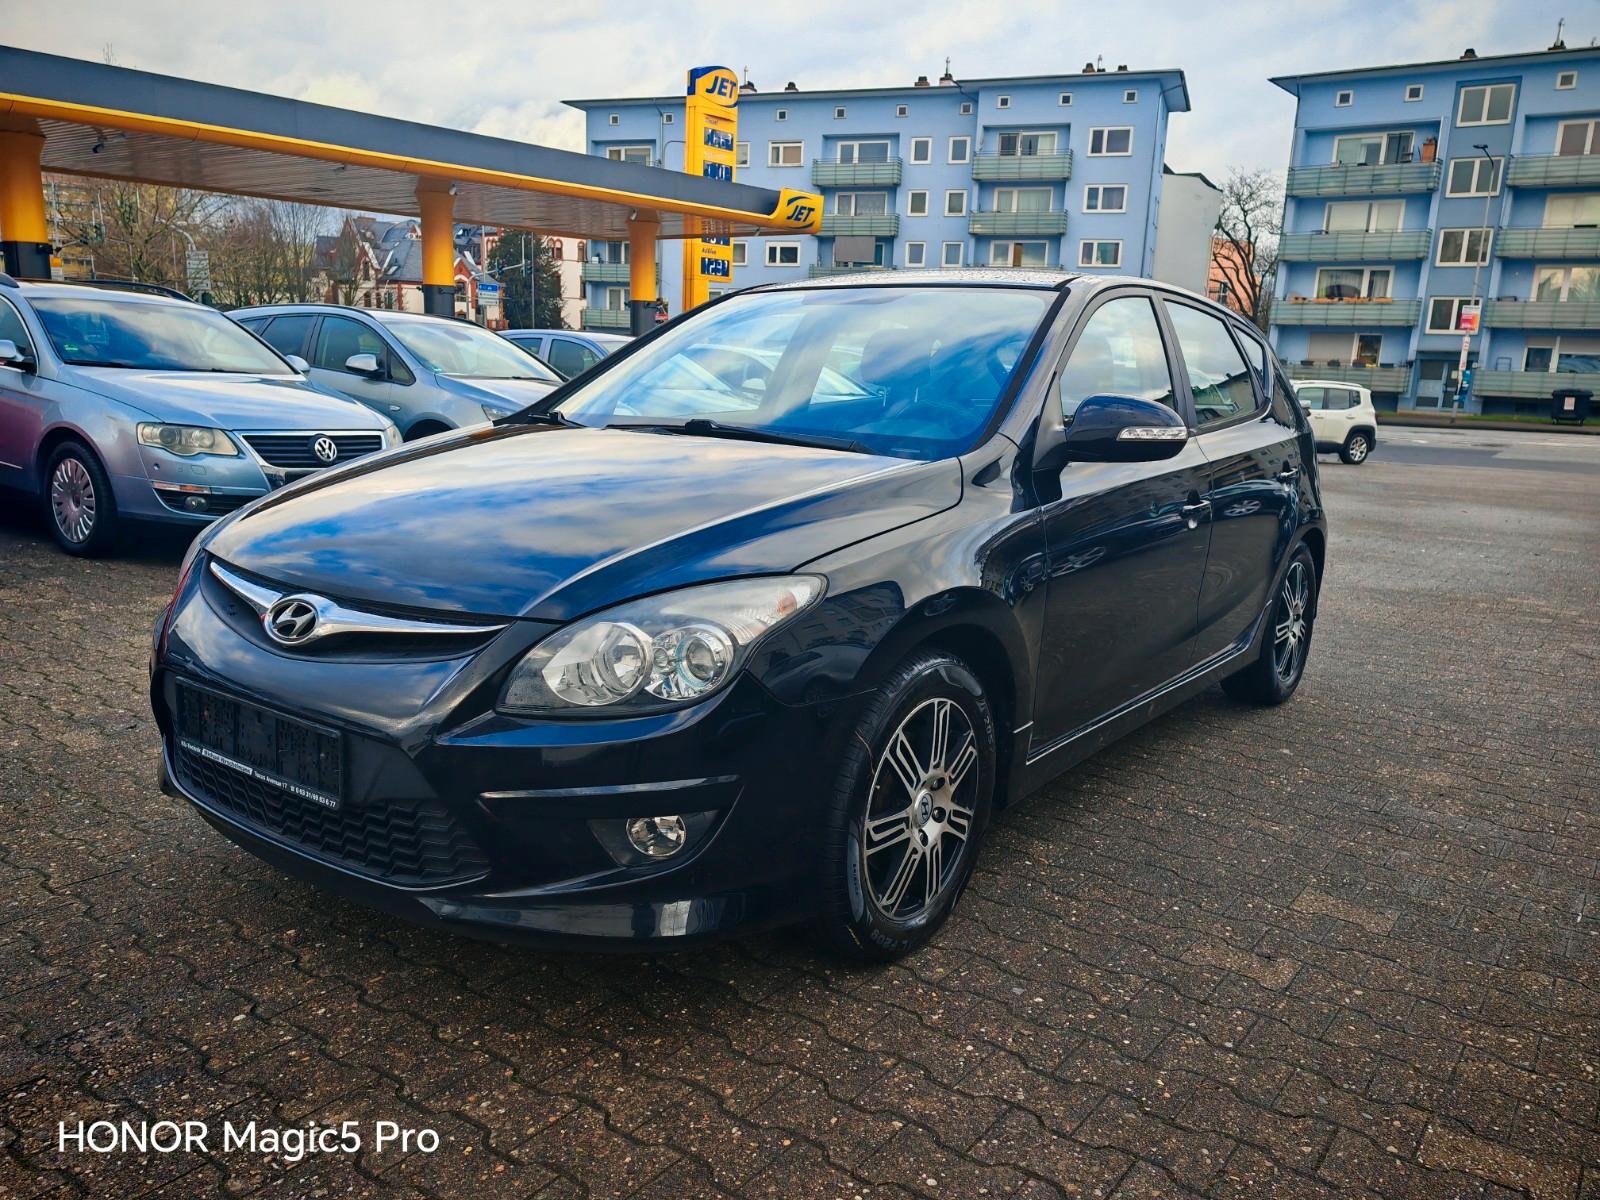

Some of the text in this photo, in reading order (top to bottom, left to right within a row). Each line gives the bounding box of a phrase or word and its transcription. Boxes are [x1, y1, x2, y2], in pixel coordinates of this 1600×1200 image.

[705, 75, 736, 99] JET
[786, 204, 816, 223] JET
[315, 438, 337, 461] VW
